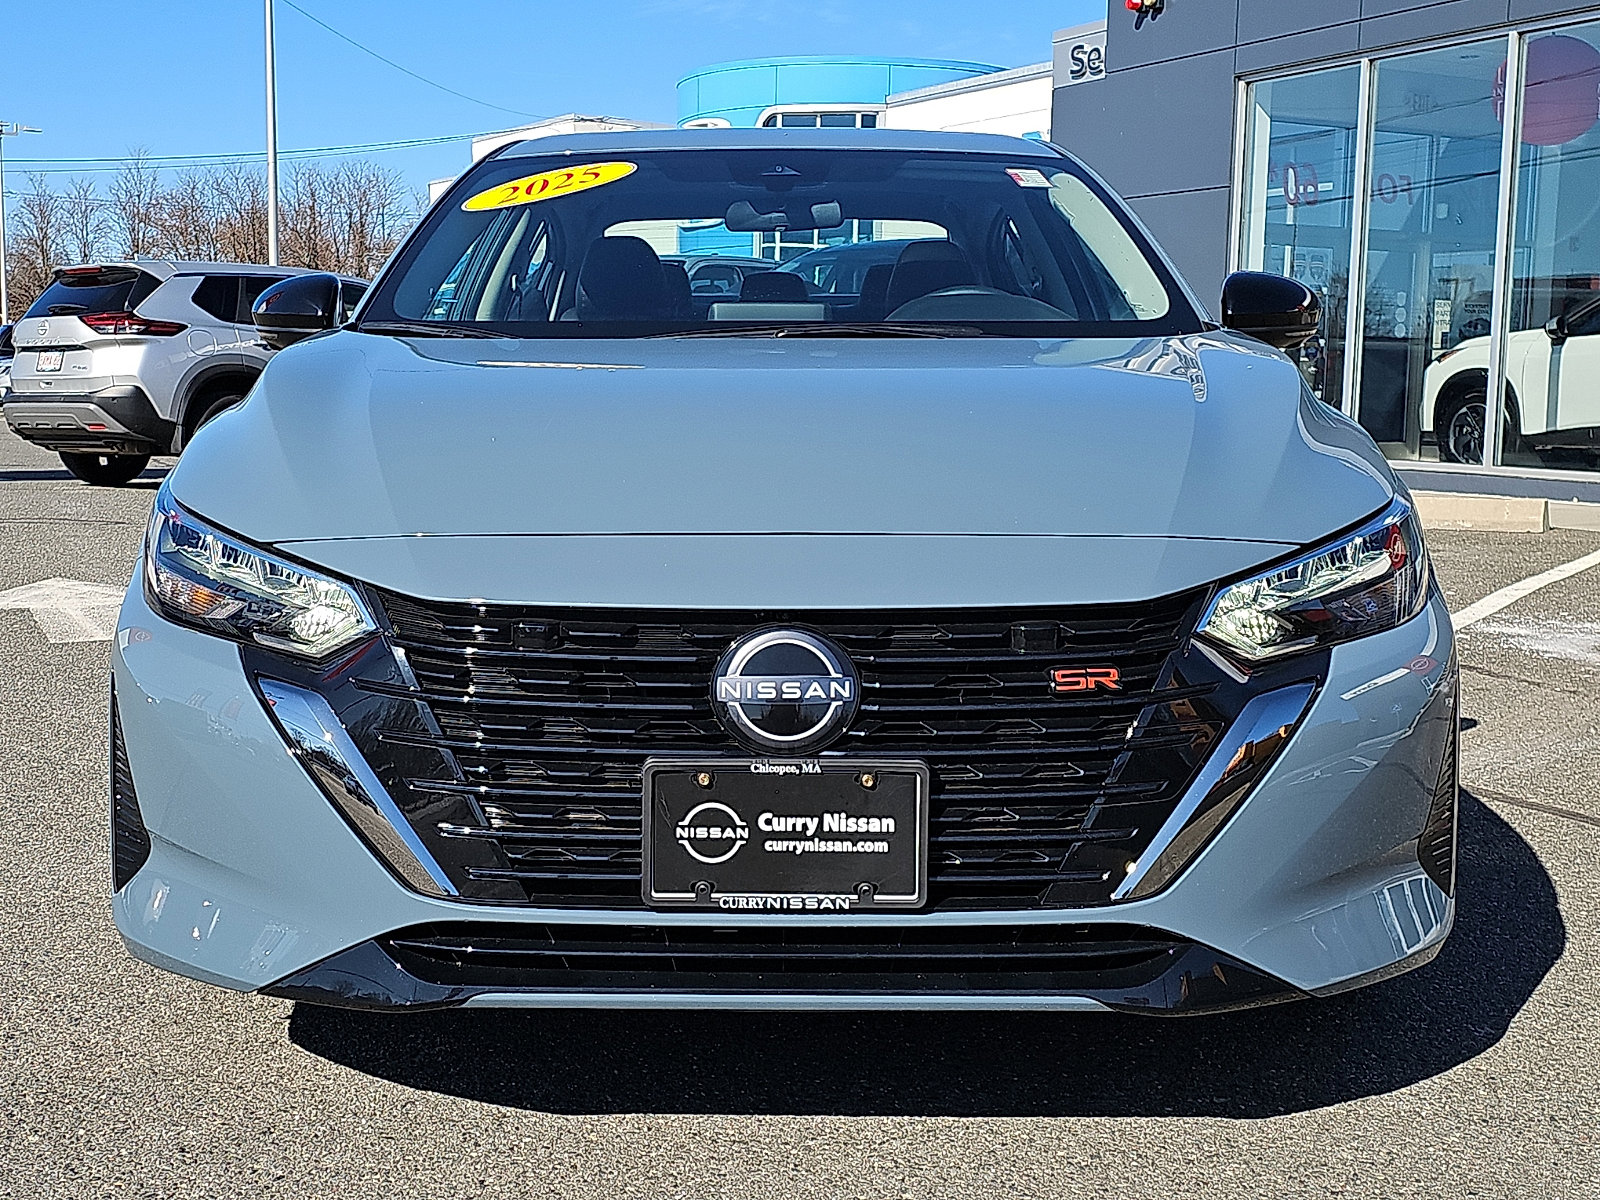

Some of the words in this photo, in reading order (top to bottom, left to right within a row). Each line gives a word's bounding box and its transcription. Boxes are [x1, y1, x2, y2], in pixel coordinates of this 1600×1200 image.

[497, 166, 602, 205] 2025
[720, 679, 851, 700] NISSAN
[1053, 667, 1120, 691] SR
[750, 763, 800, 776] Chicopee,
[801, 763, 822, 774] MA
[675, 826, 749, 839] NISSAN
[757, 812, 819, 836] Curry
[823, 812, 896, 833] Nissan
[764, 838, 889, 855] currynissan.com
